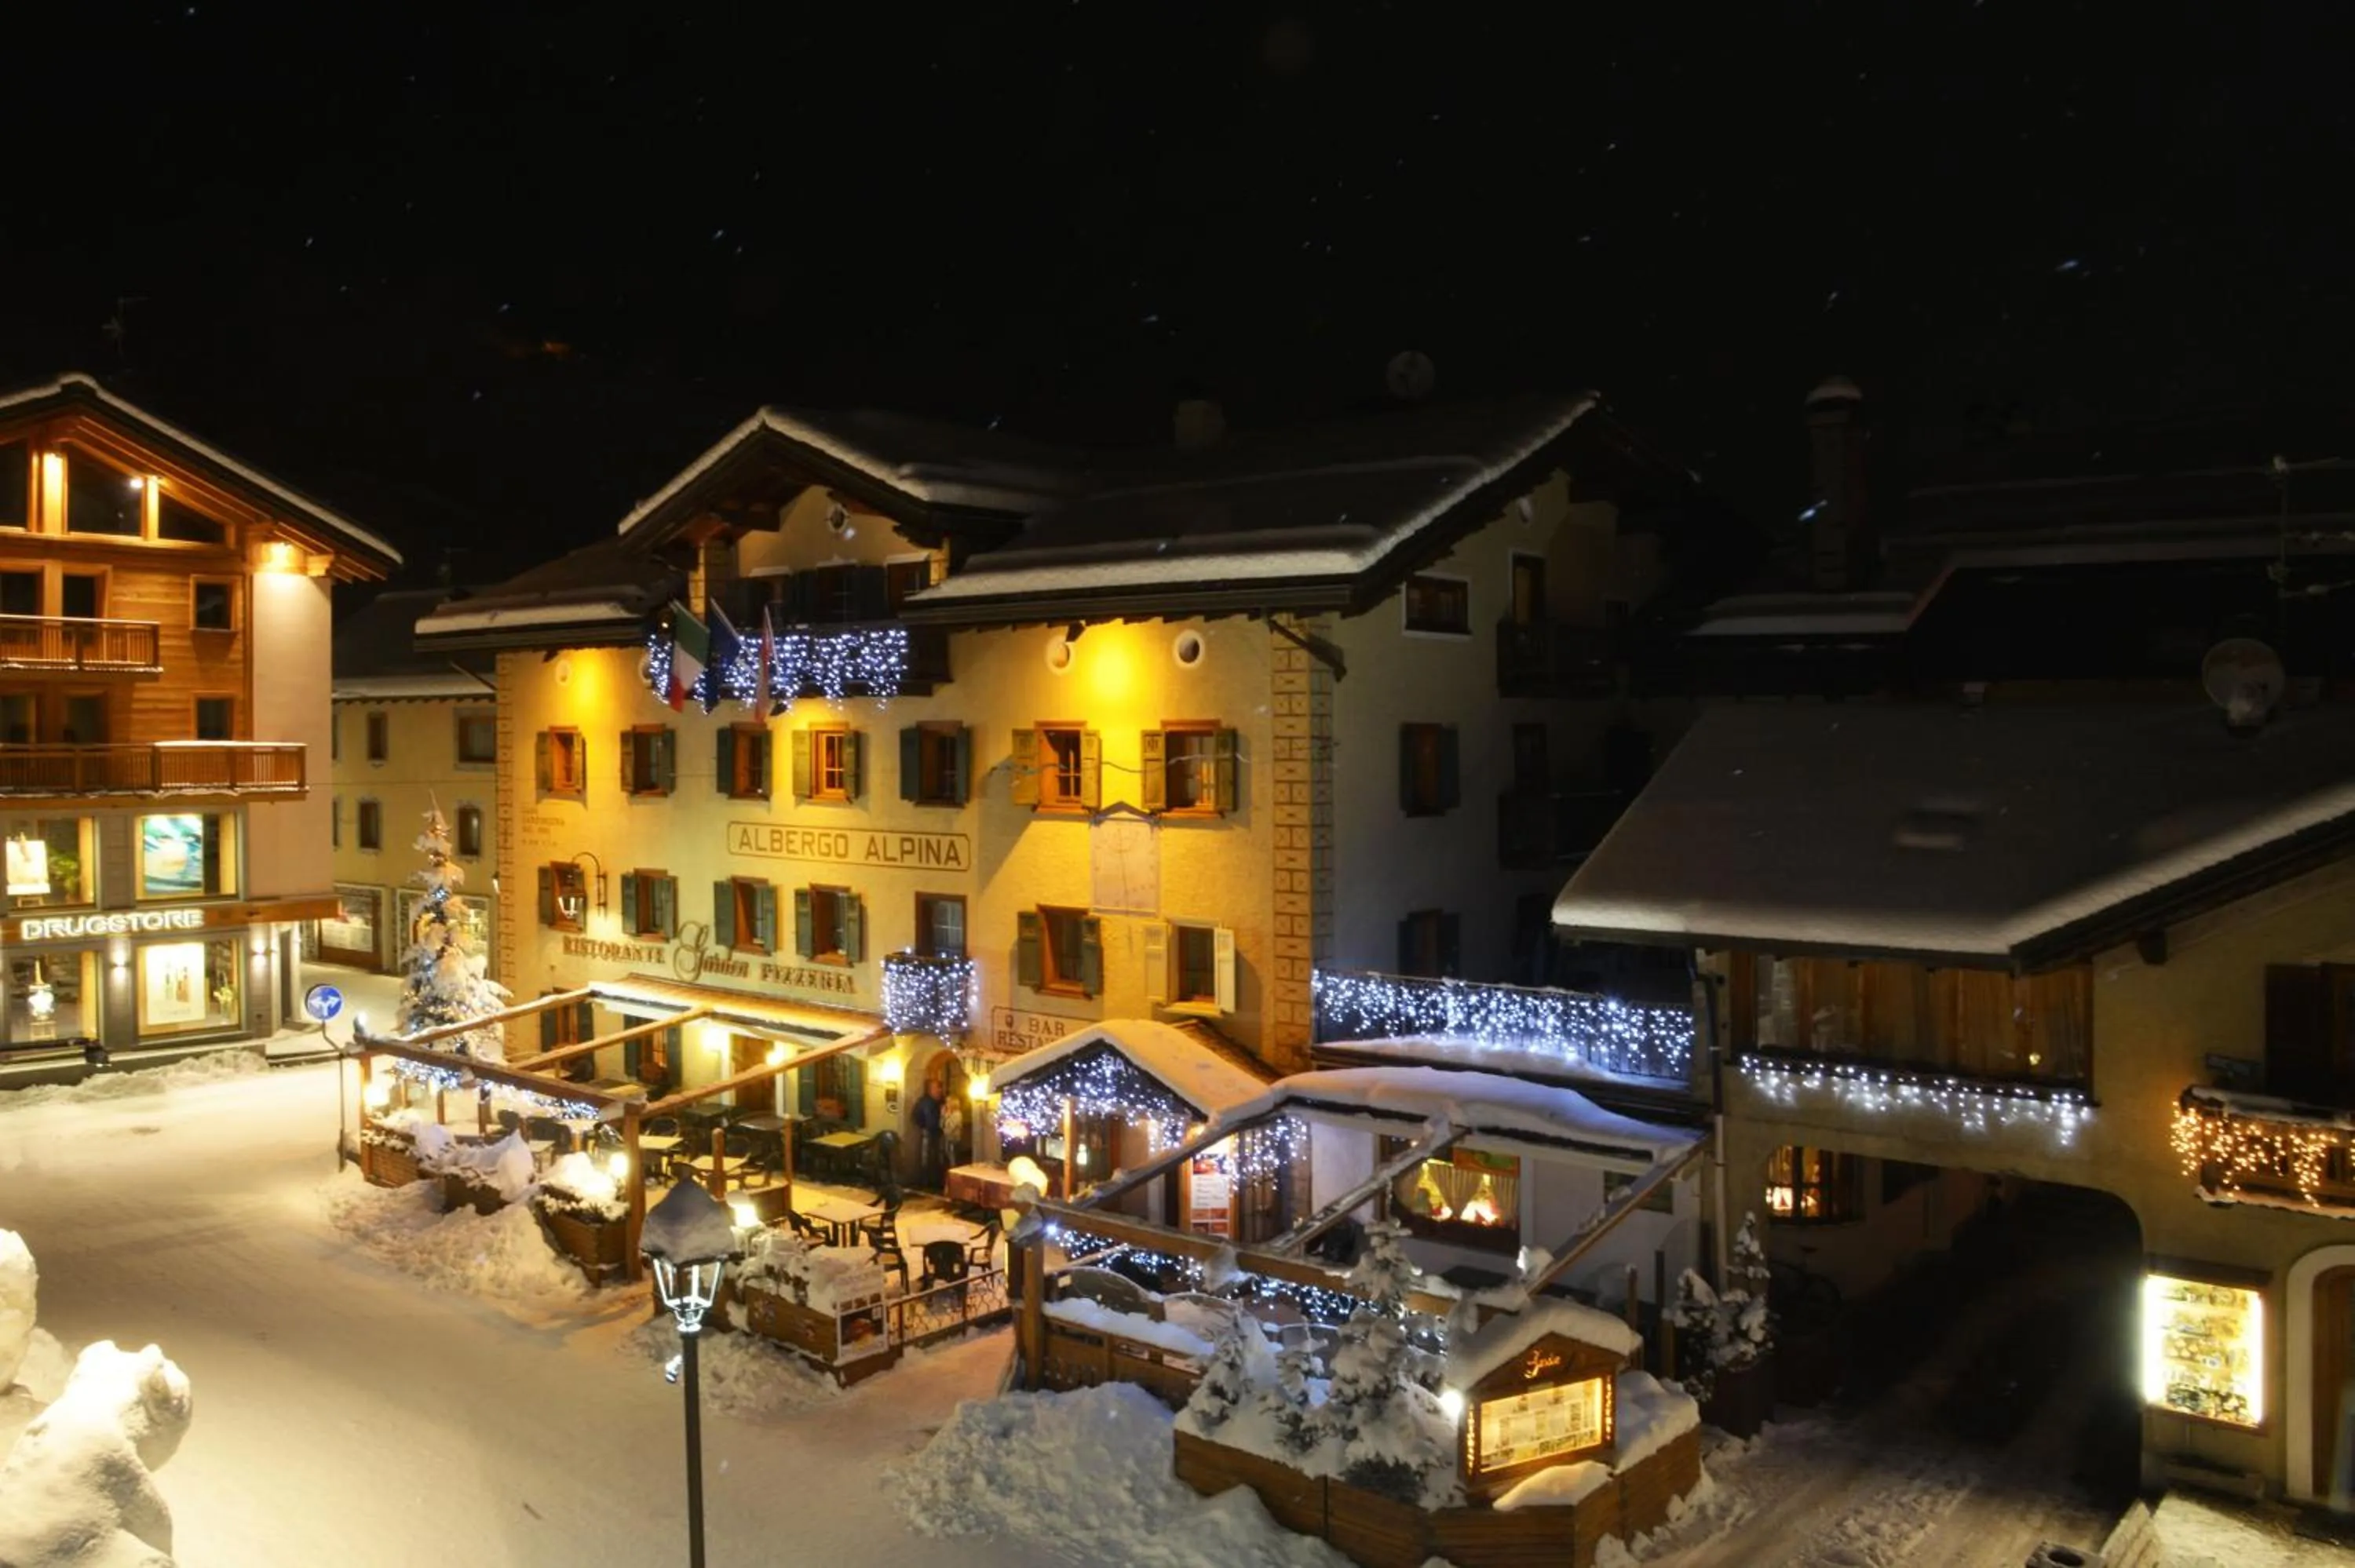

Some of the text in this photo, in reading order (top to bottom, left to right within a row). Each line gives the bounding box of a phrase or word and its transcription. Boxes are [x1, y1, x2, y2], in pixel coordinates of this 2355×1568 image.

[739, 827, 962, 866] ALBERGO ALPINA
[21, 909, 205, 940] DRUGSTORE
[563, 935, 666, 965] RISTORANTE
[1028, 1017, 1066, 1037] BAR
